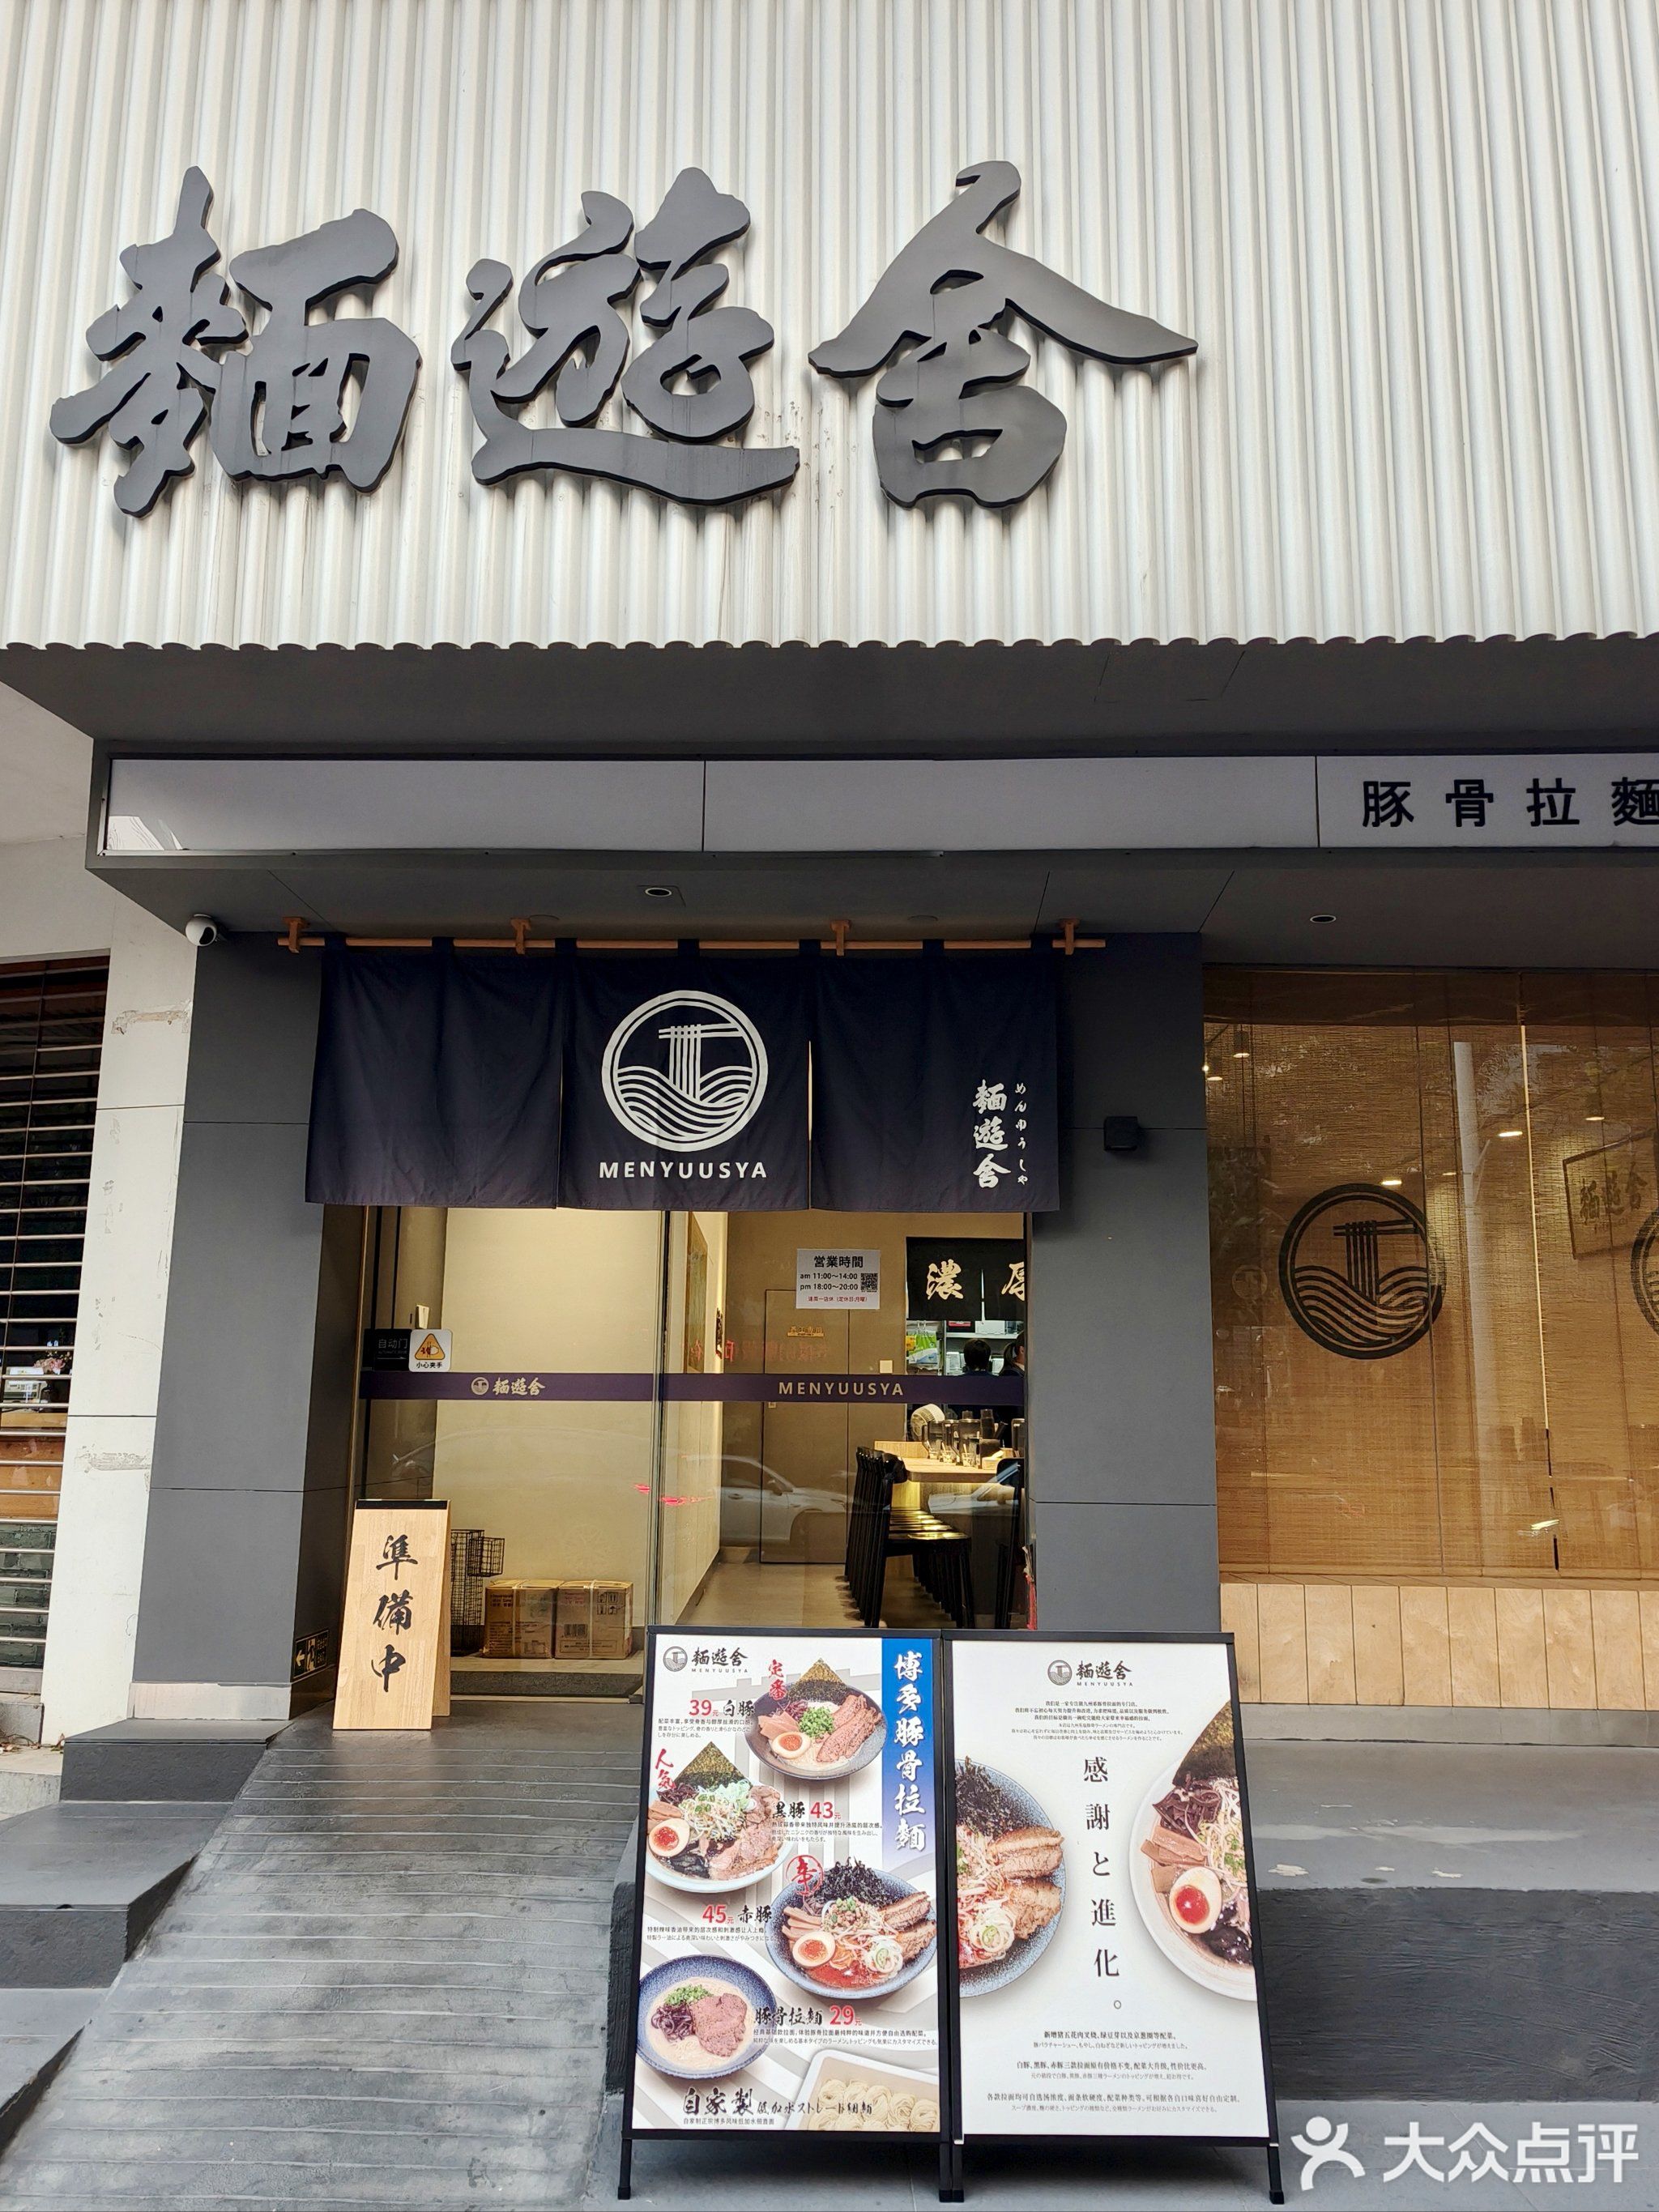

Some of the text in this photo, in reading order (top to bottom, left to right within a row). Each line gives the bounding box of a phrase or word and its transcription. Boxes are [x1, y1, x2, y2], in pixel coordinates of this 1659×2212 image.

[1362, 776, 1659, 828] 豚骨拉麵
[599, 1161, 767, 1179] MENYUUSYA
[813, 1255, 864, 1268] 営業時間
[378, 1338, 408, 1349] 自动门
[778, 1382, 904, 1396] MENYUUSYA
[376, 1534, 418, 1693] 準備中
[723, 1699, 755, 1717] 白豚
[738, 1904, 772, 1924] 赤豚
